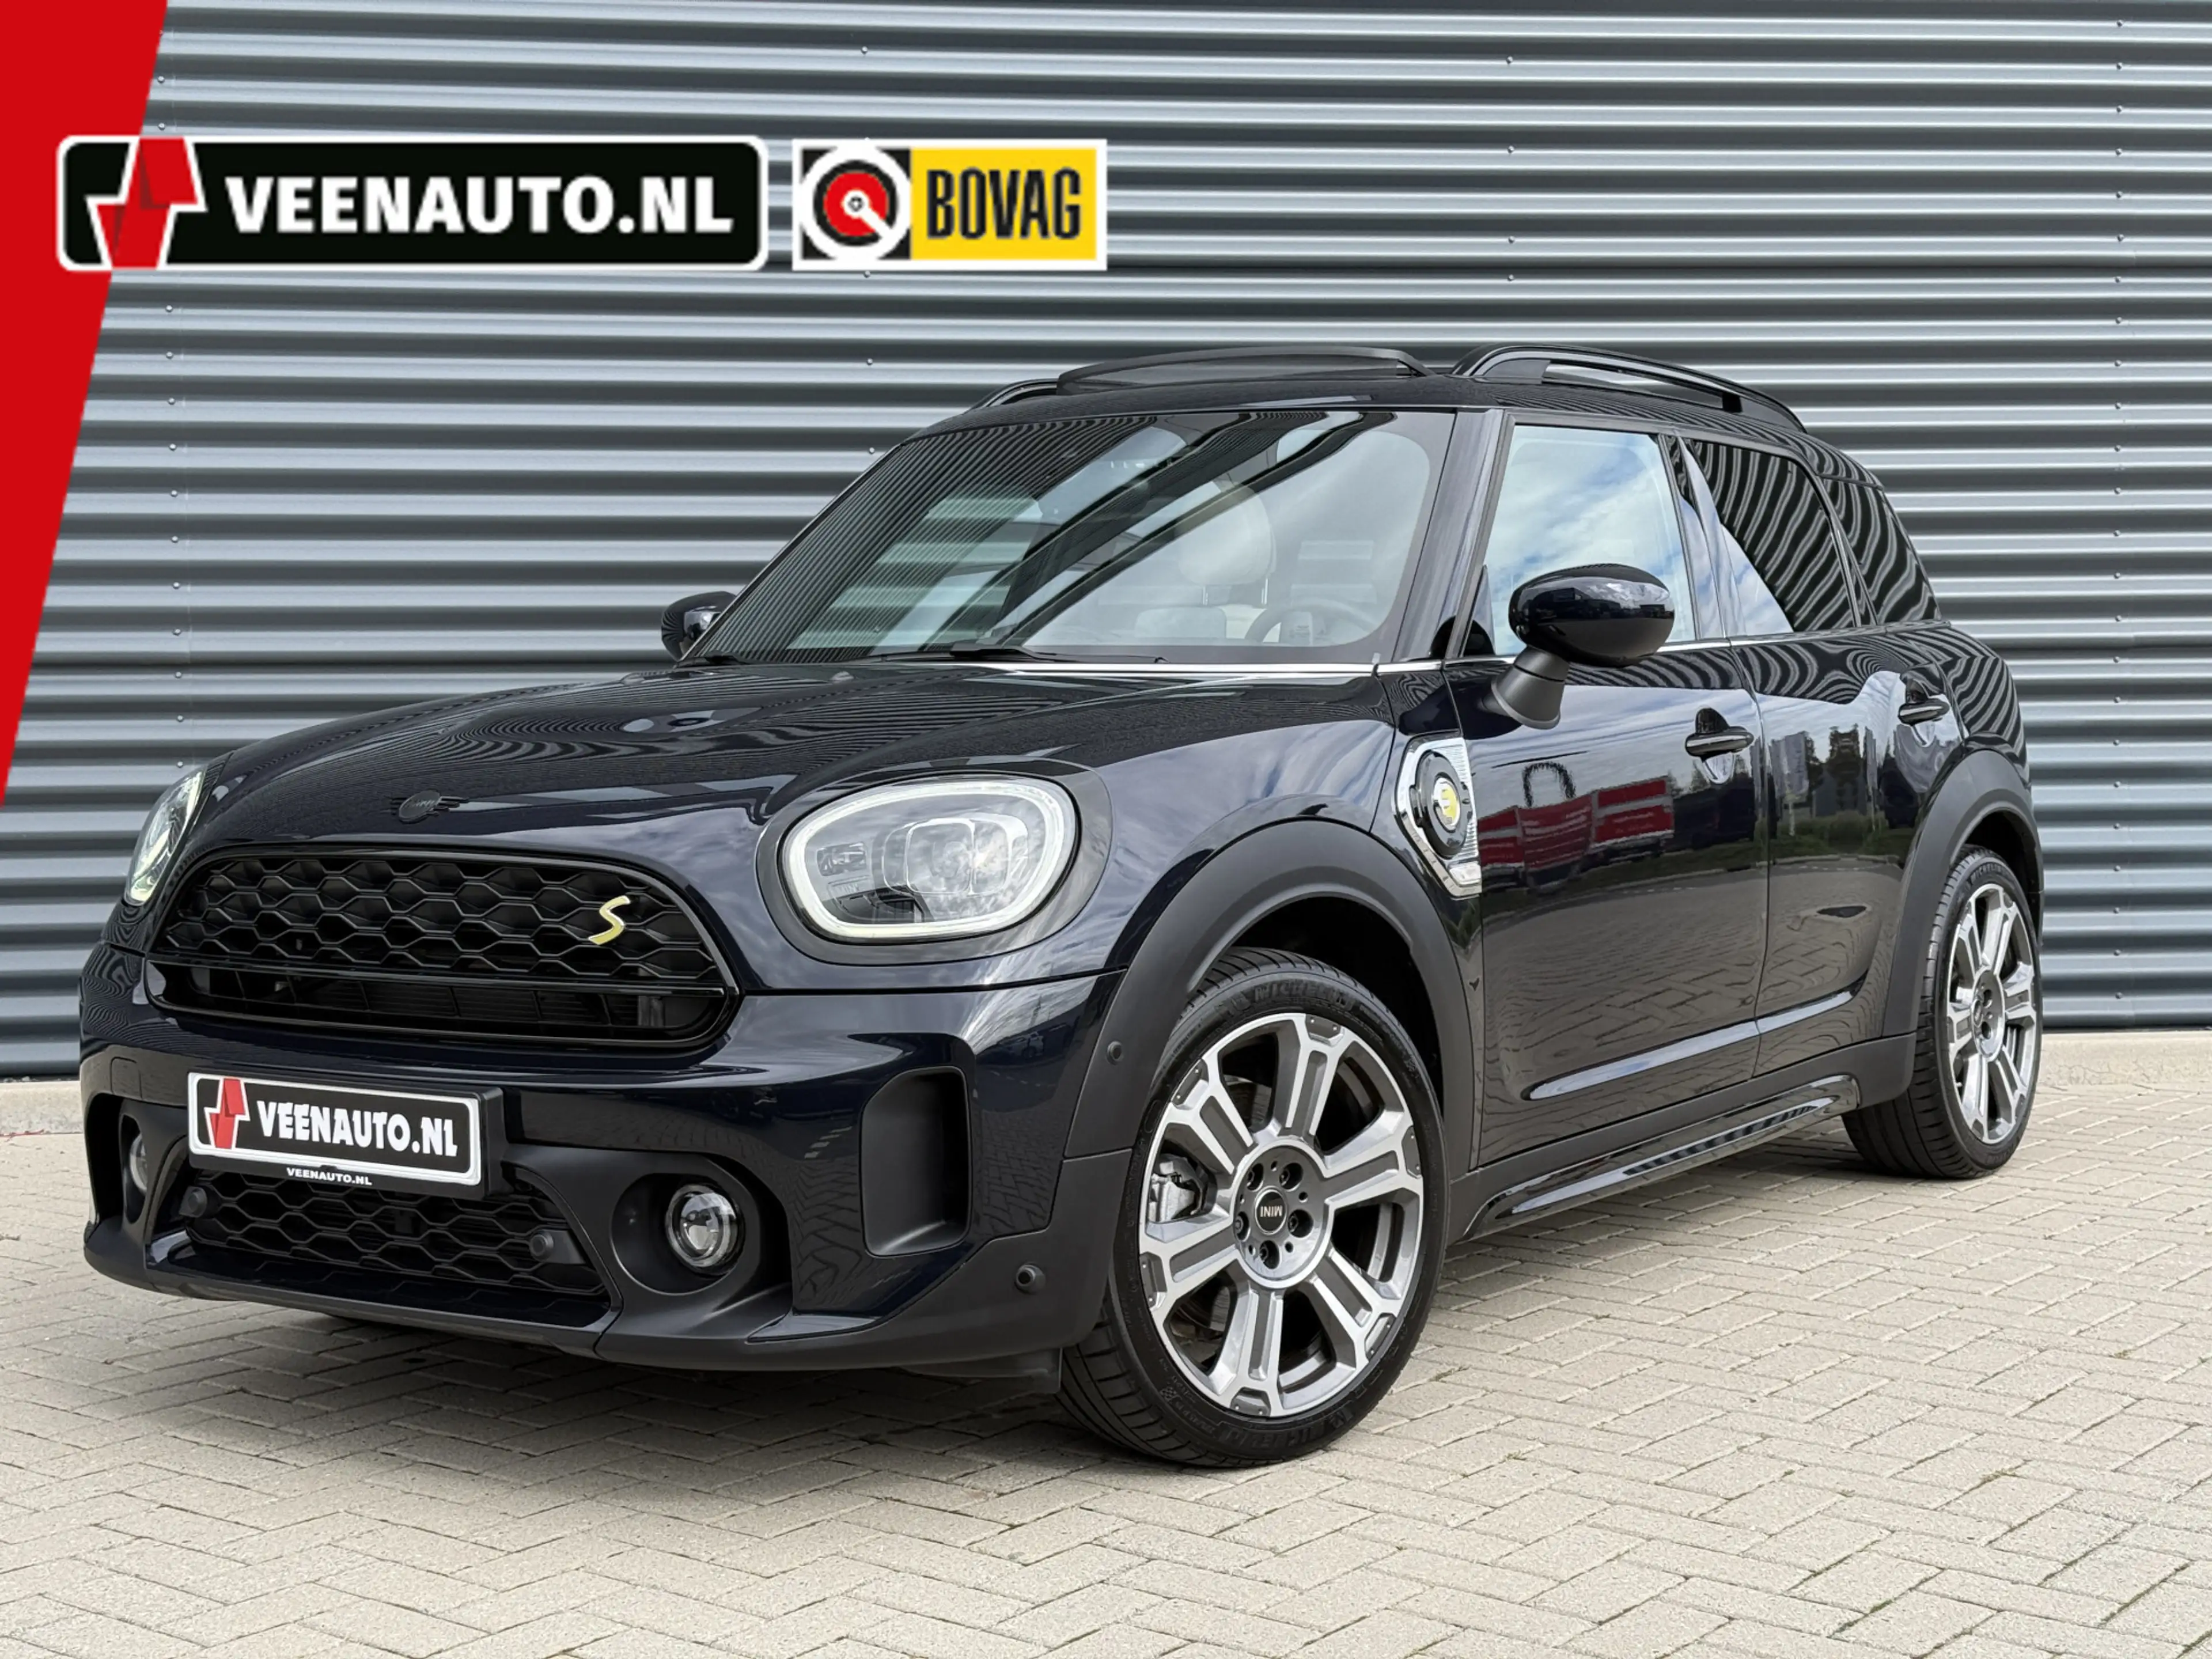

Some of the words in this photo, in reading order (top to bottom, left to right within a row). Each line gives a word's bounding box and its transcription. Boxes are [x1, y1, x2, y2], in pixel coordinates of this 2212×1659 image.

[588, 895, 631, 945] S
[256, 1101, 458, 1157] VEENAUTO.NL
[286, 1168, 372, 1185] VEENAUTO.NL
[1260, 1205, 1283, 1217] MINI
